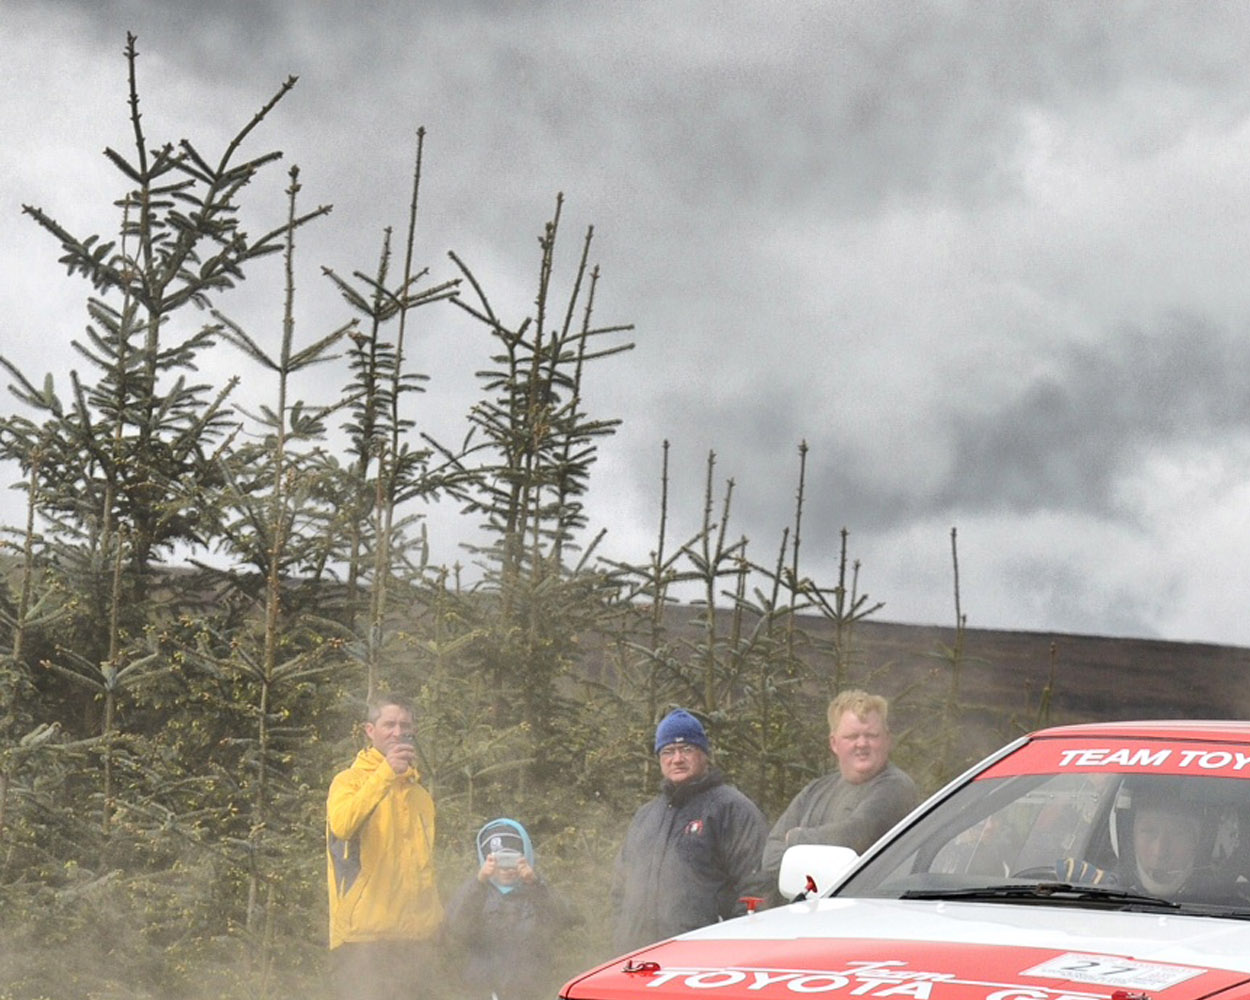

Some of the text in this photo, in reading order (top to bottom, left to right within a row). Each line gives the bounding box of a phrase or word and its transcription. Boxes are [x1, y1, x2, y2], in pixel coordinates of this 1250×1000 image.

[1058, 748, 1173, 767] TEAM
[1059, 960, 1135, 976] 27
[645, 970, 933, 1000] TOYOTA
